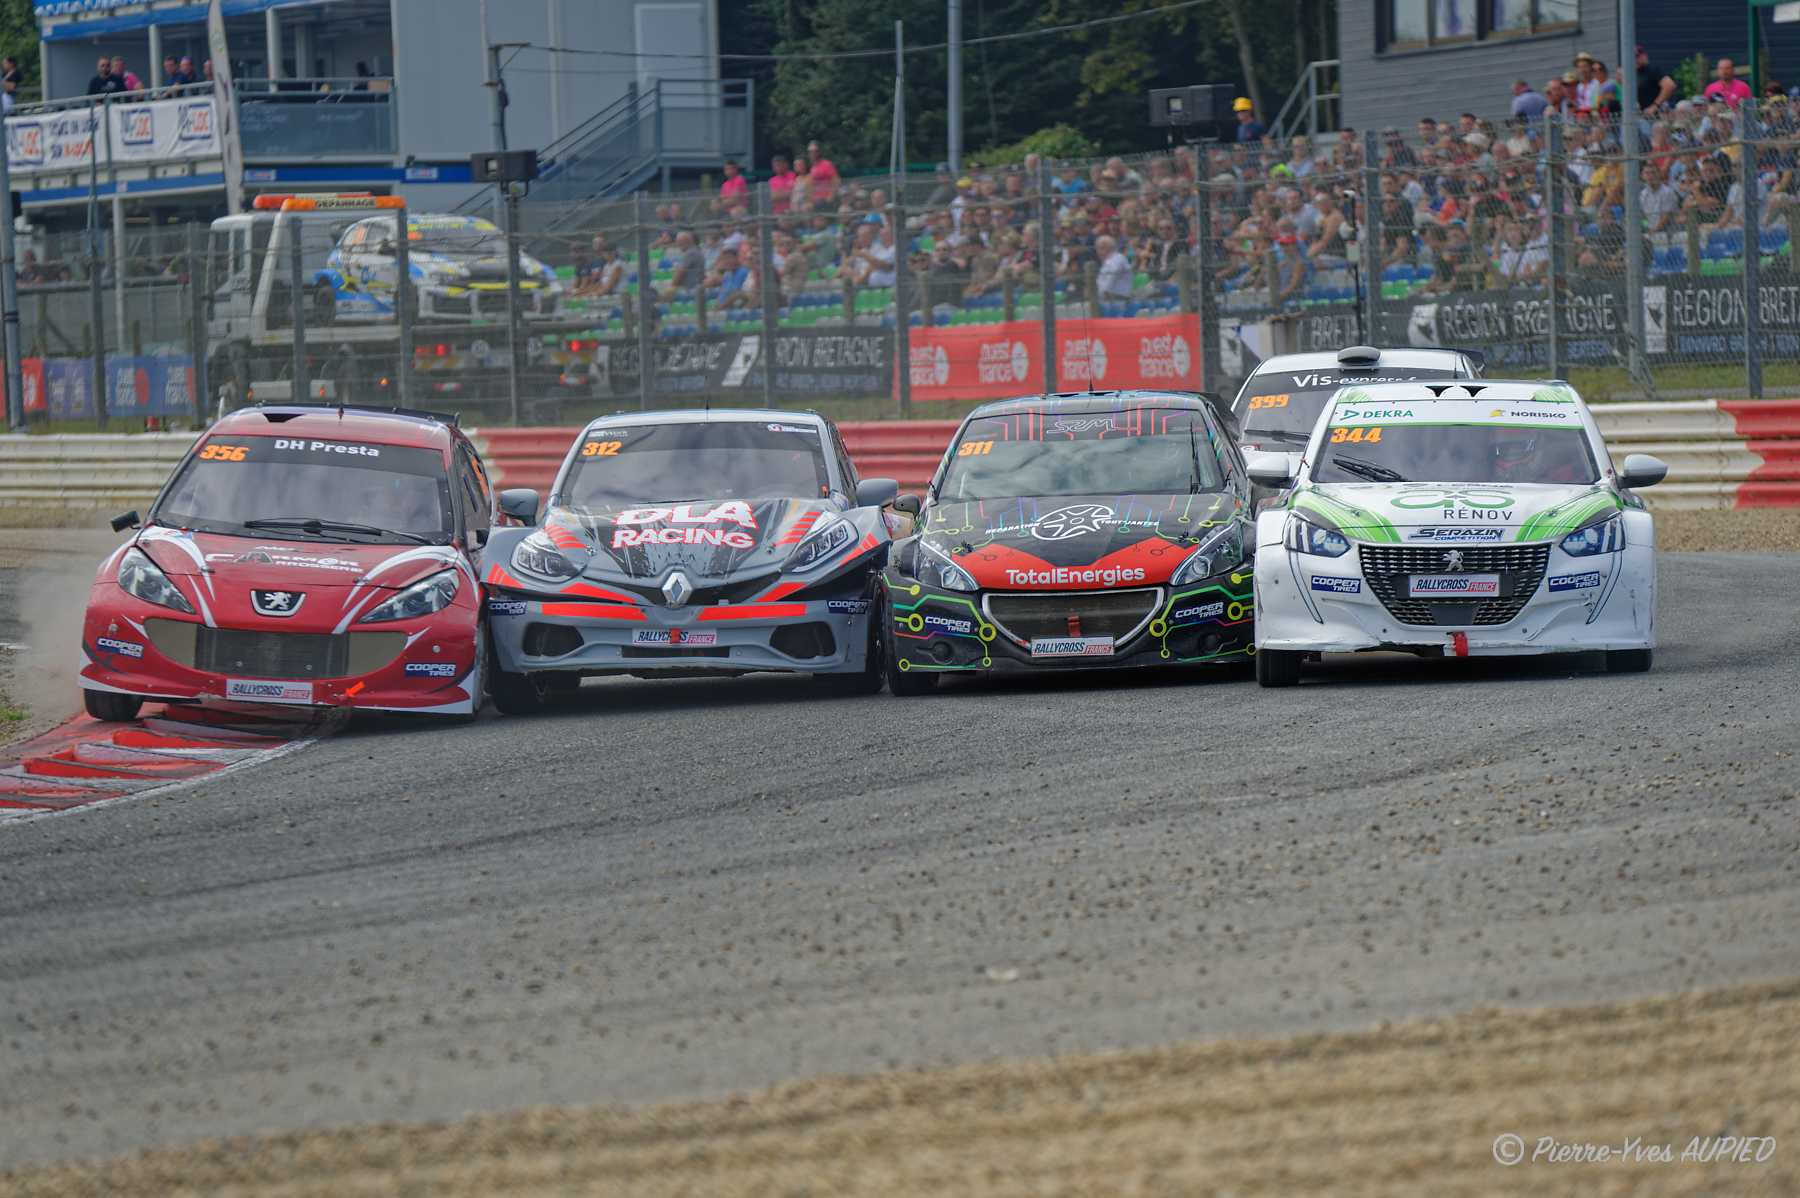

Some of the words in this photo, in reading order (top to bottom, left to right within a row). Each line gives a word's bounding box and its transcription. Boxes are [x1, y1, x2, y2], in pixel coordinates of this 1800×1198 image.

[1248, 394, 1290, 410] 399
[1363, 410, 1414, 418] DEKRA
[1510, 411, 1567, 419] NORISKO
[1330, 427, 1383, 444] 344
[200, 444, 249, 461] 356
[274, 439, 304, 450] DH
[310, 441, 380, 457] Presta
[582, 441, 622, 456] 312
[959, 440, 994, 457] 311
[612, 501, 758, 529] DLA
[1443, 507, 1513, 521] RÉNOV
[610, 528, 756, 550] RACING
[1410, 528, 1505, 539] SERAZIN
[1005, 565, 1146, 586] TotalEnergies
[1312, 576, 1360, 587] COOPER
[1551, 573, 1599, 585] COOPER
[1415, 579, 1469, 590] RALLYCROSS
[1469, 582, 1496, 592] FRANCE
[1575, 580, 1600, 588] TIRES
[490, 602, 527, 610] COOPER
[1175, 602, 1224, 619] COOPER
[1199, 608, 1224, 618] TIRES
[925, 616, 971, 628] COOPER
[947, 624, 971, 633] TIRES
[97, 638, 144, 653] COOPER
[1034, 641, 1085, 654] RALLYCROSS
[405, 663, 457, 672] COOPER
[232, 683, 284, 697] RALLYCROSS
